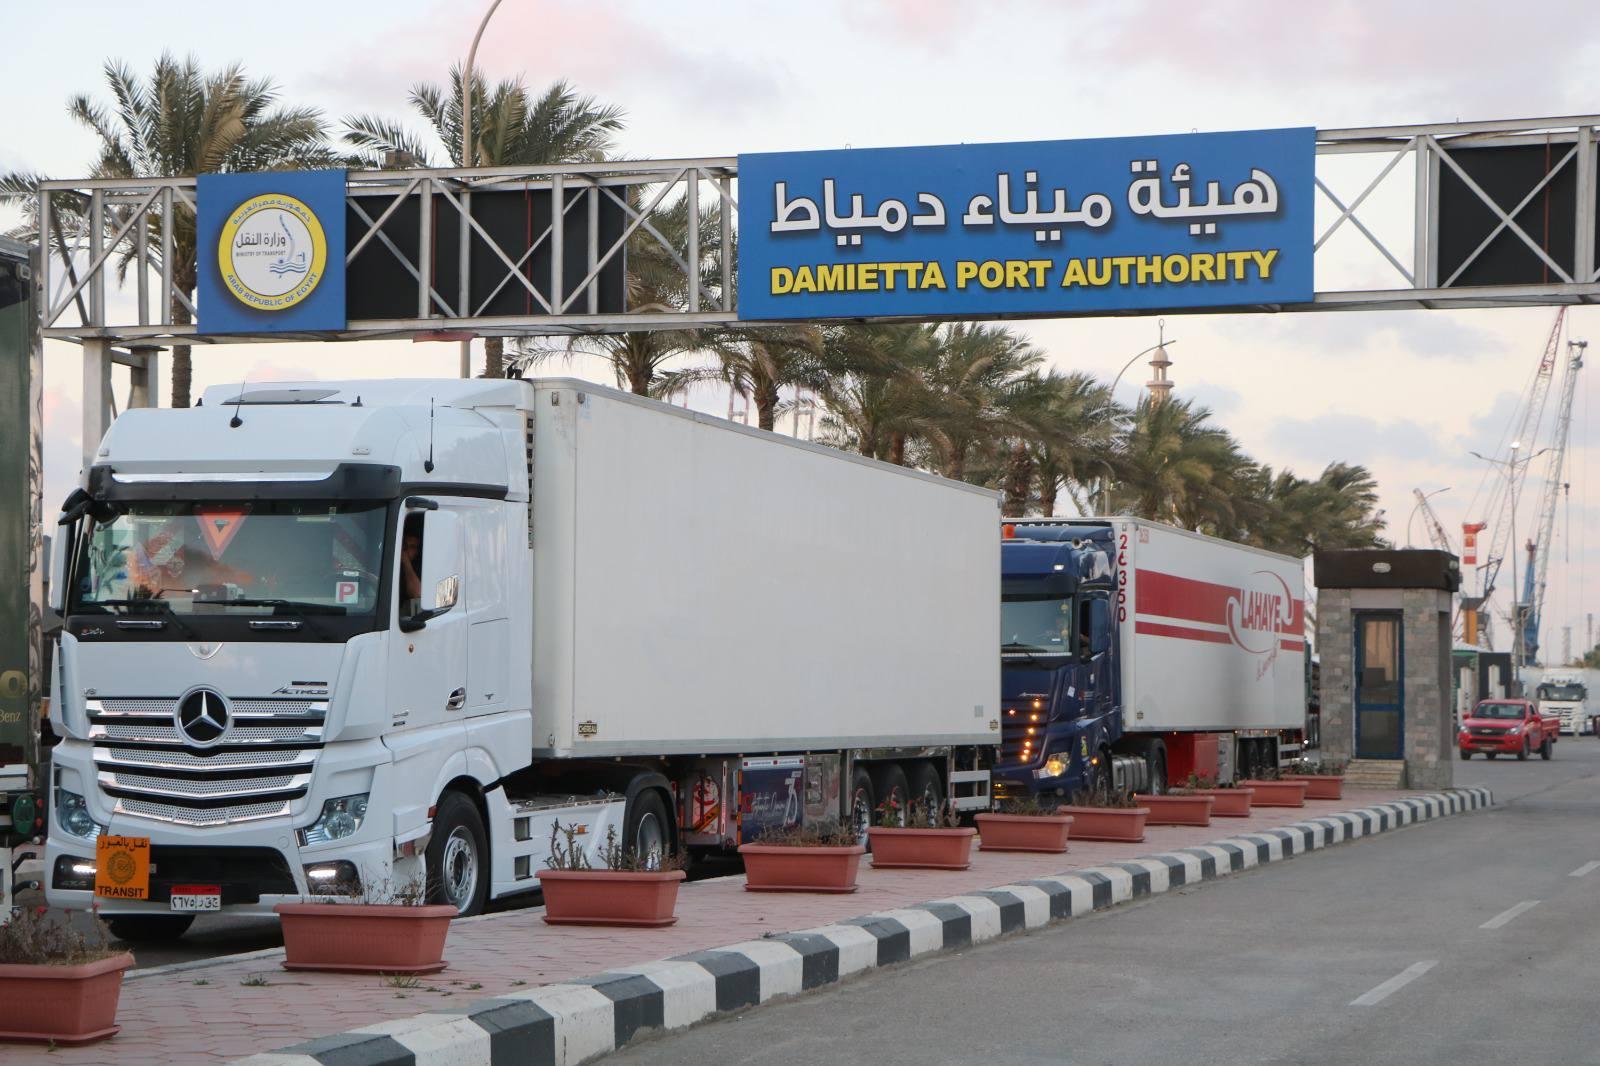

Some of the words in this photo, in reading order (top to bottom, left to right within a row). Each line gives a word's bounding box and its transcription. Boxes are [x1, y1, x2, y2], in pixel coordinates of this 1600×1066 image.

[771, 179, 946, 245] دمياط
[963, 170, 1112, 241] ميناء
[1128, 160, 1279, 235] هيئة
[236, 232, 262, 248] النقل
[263, 232, 286, 247] وزارة
[228, 274, 244, 294] ARAB
[243, 292, 283, 306] REPUBLIC
[285, 294, 295, 302] OF
[296, 272, 317, 297] EGYPT
[771, 262, 946, 294] DAMIETTA
[956, 259, 1052, 288] PORT
[1062, 249, 1279, 288] AUTHORITY
[339, 583, 356, 603] P
[1241, 589, 1282, 633] LAHAYE
[98, 886, 145, 898] TRANSIT
